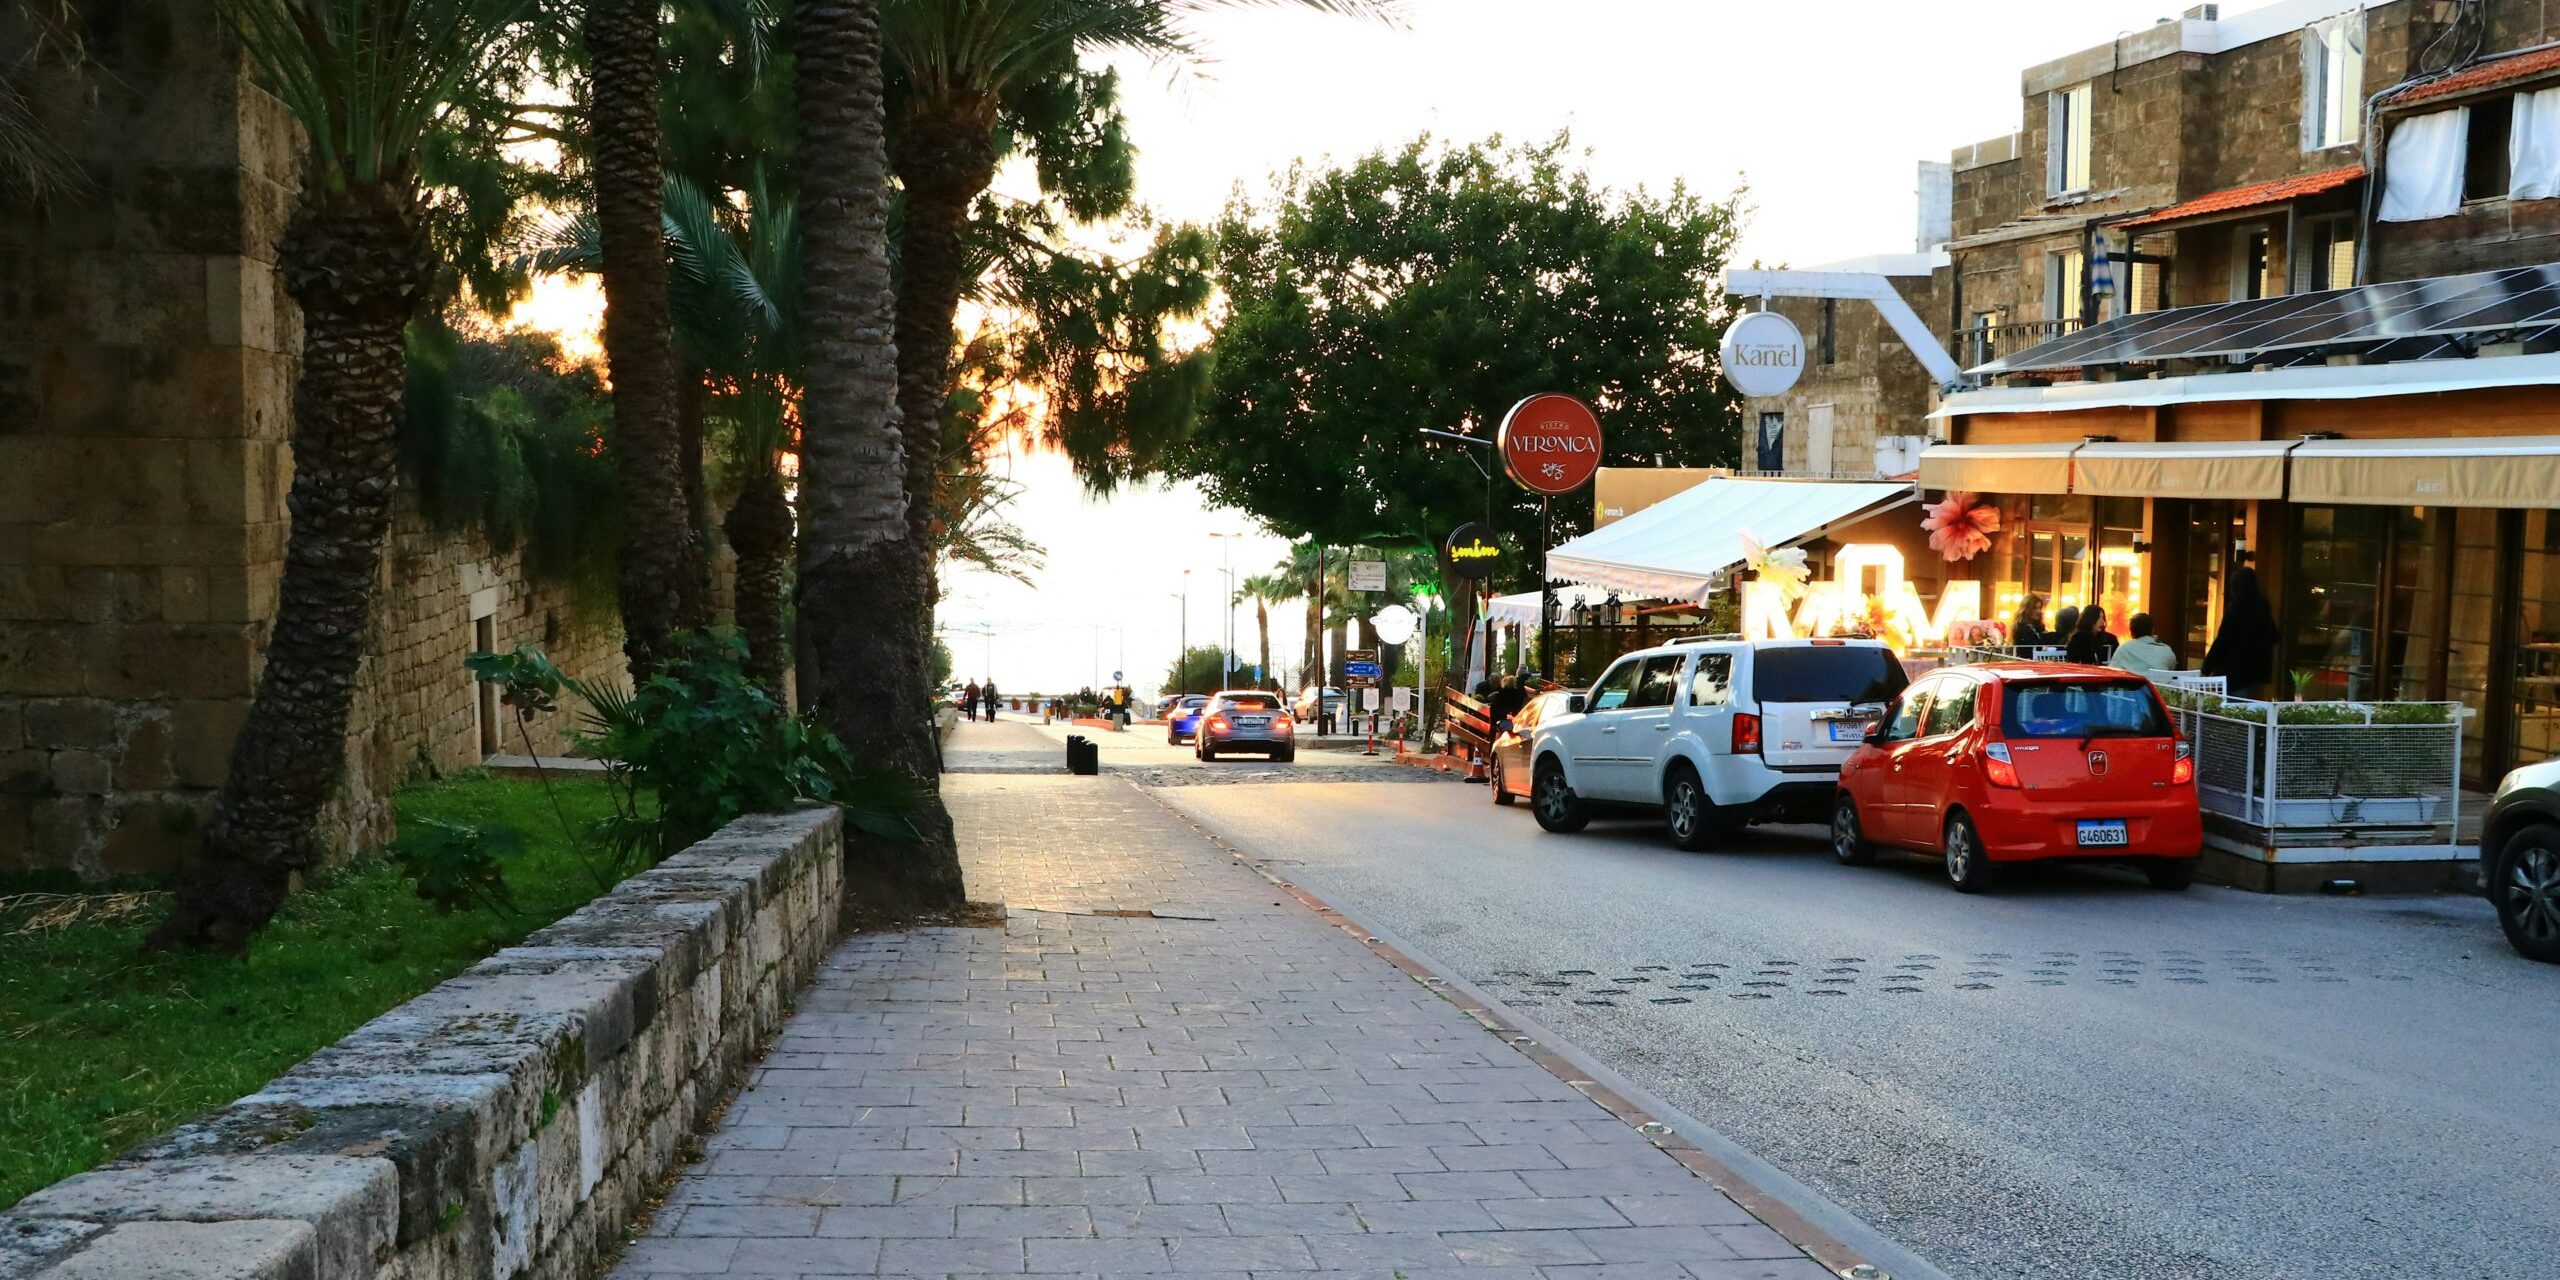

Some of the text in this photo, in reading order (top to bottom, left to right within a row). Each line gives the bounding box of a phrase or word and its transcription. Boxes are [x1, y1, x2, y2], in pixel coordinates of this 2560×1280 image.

[1734, 343, 1798, 367] Kanel
[1512, 435, 1596, 453] VERONICA
[2079, 829, 2126, 844] G460631
